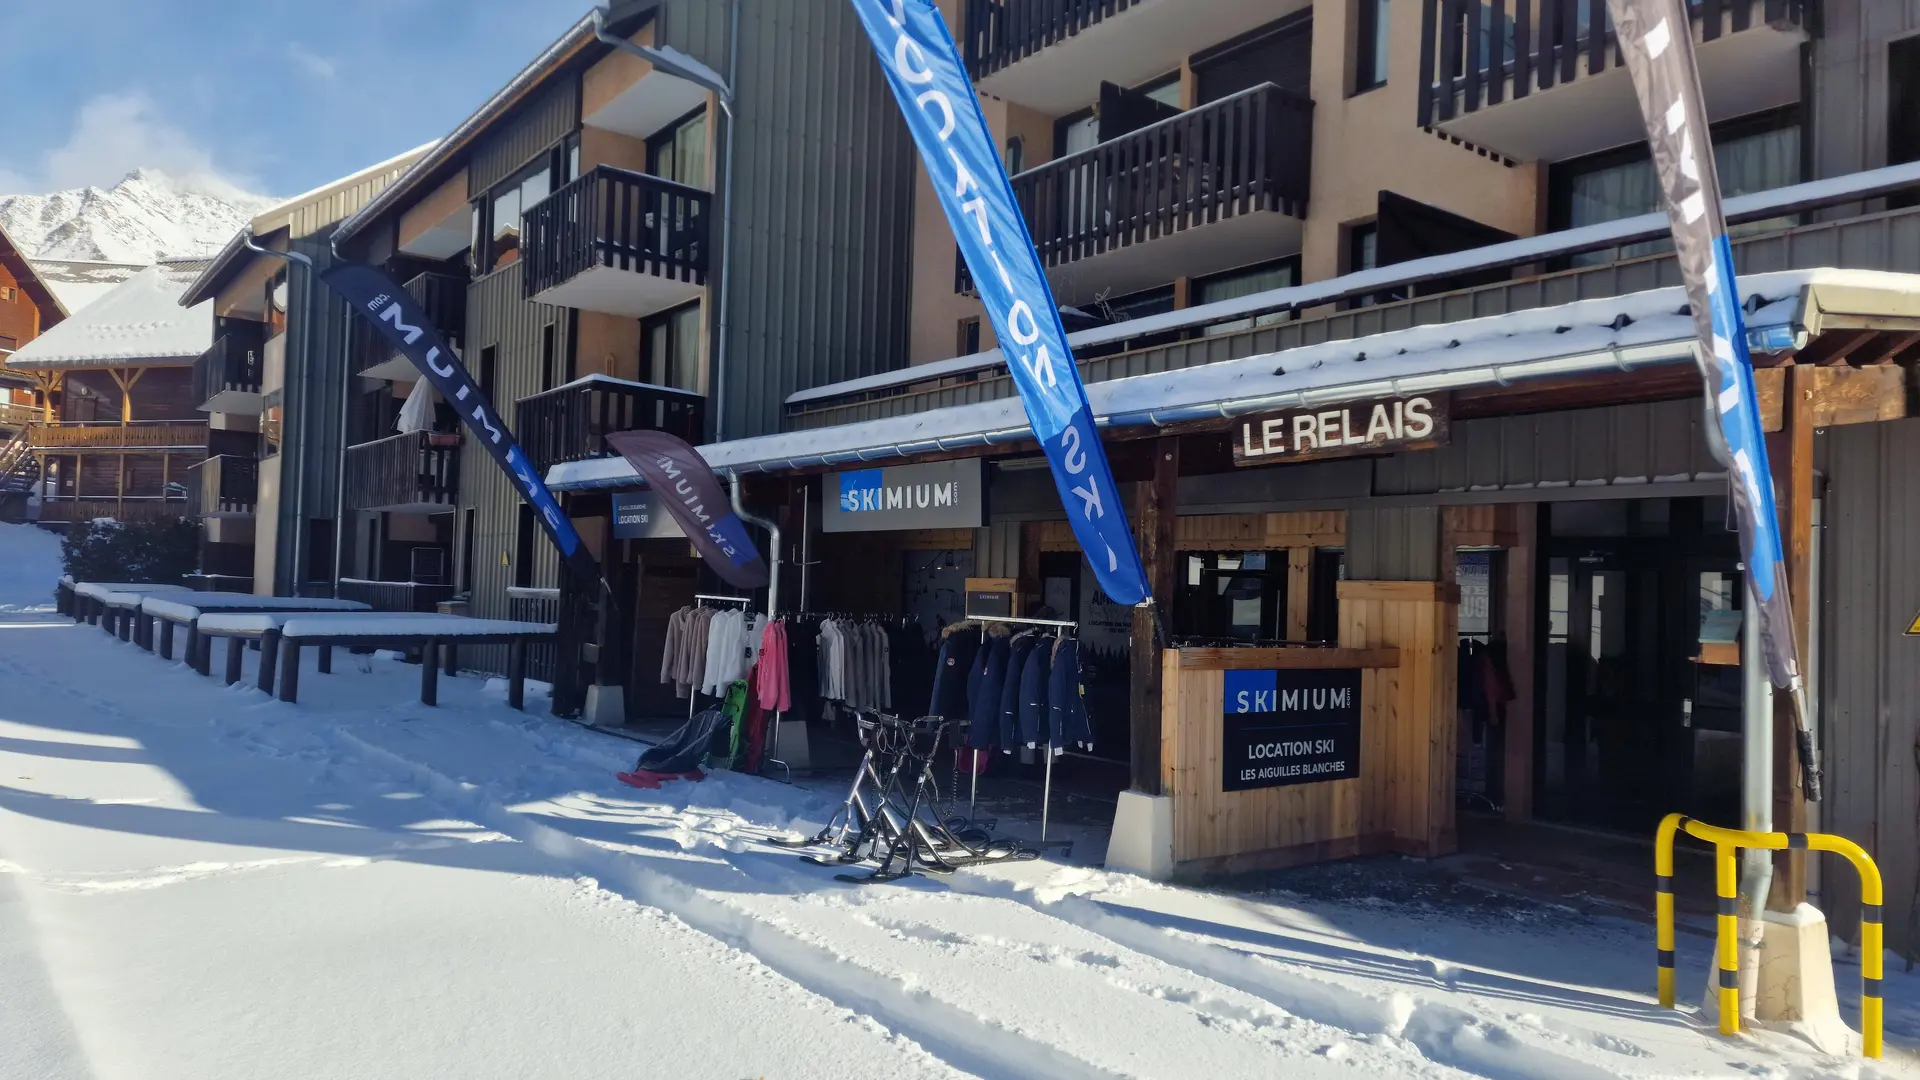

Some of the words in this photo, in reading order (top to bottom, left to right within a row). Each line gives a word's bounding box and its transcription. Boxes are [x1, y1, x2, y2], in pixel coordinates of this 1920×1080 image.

[1243, 418, 1285, 457] LE
[1292, 397, 1434, 451] RELAIS
[848, 482, 952, 512] SKIMIUM
[618, 515, 640, 525] LOCATION
[641, 514, 649, 523] SKI
[1237, 687, 1346, 714] SKIMIUM
[1248, 740, 1312, 760] LOCATION
[1315, 739, 1335, 754] SKI
[1240, 769, 1256, 781] LES
[1258, 765, 1301, 779] AIGUILLES
[1302, 761, 1345, 775] BLANCHES
